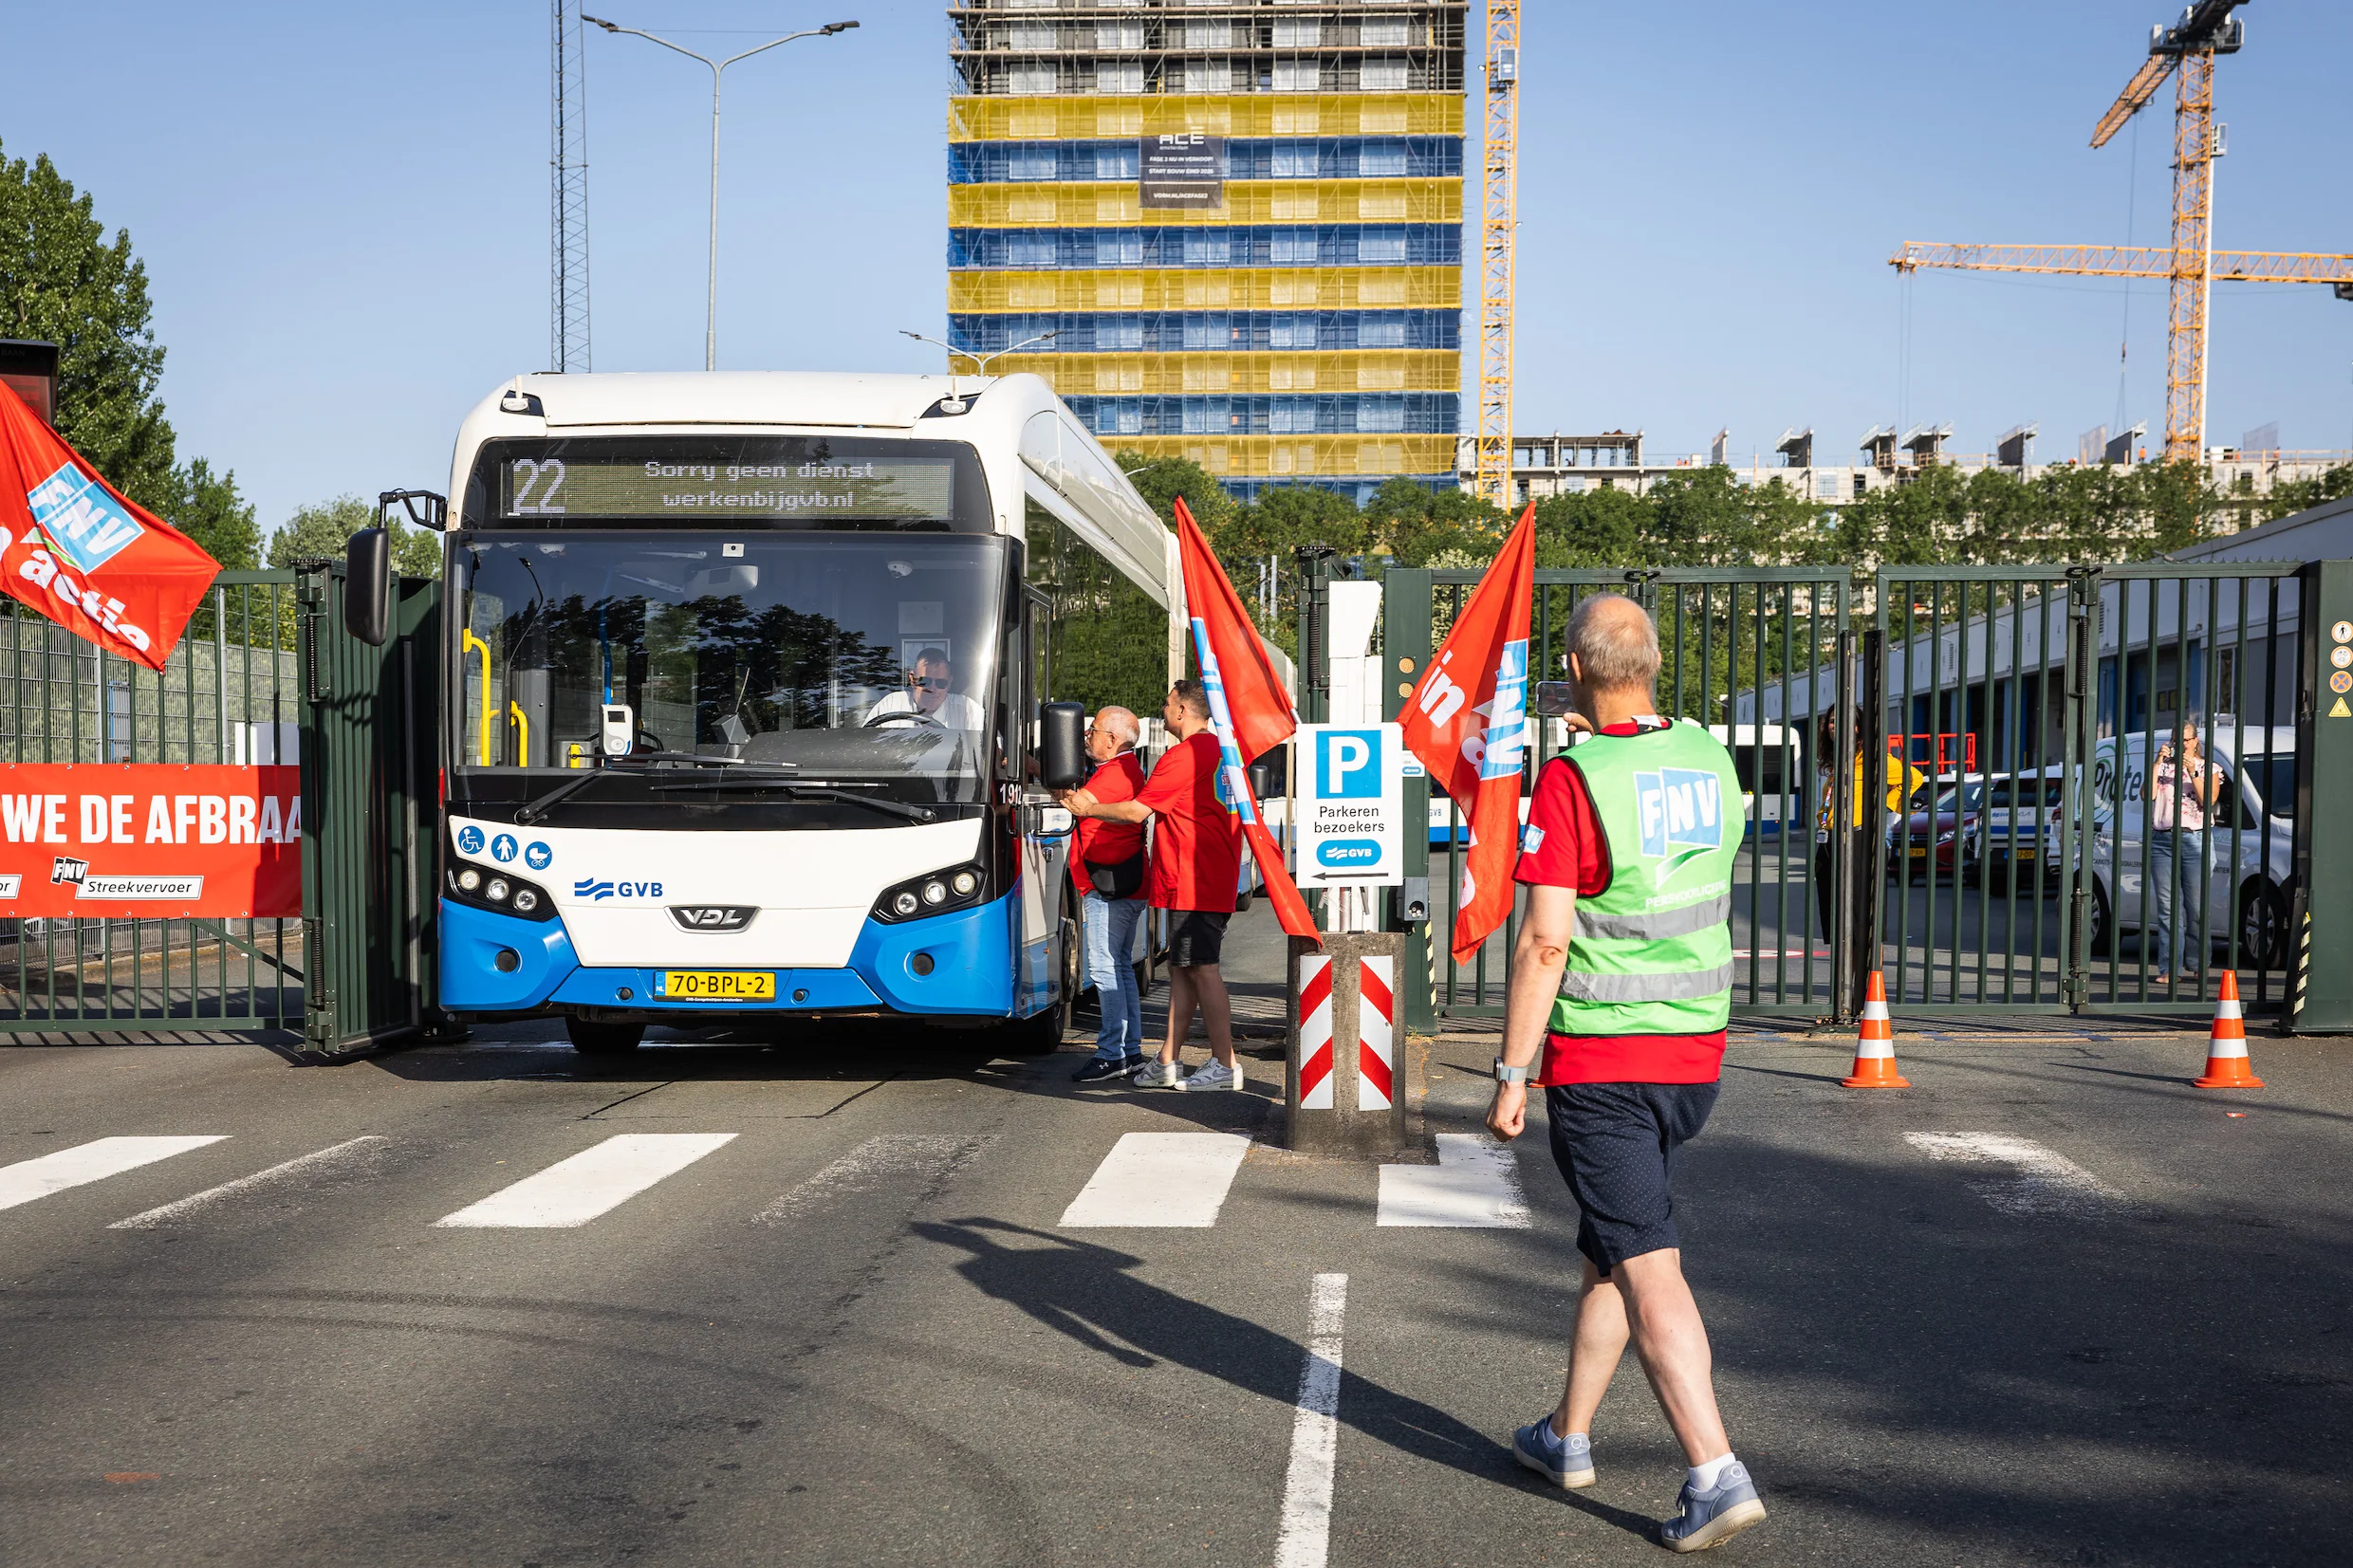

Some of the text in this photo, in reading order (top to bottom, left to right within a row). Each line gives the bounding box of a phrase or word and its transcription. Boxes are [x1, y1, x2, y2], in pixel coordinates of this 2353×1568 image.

[1159, 126, 1204, 144] ACE
[644, 461, 874, 482] Sorry geen dienst
[512, 458, 565, 514] 22
[663, 490, 853, 510] werkenbijgvb.nl
[29, 479, 137, 555] FNV
[18, 549, 150, 653] actie
[1328, 736, 1370, 794] P
[999, 784, 1022, 805] 1912
[1319, 806, 1380, 818] Parkeren
[1641, 778, 1717, 839] FNV
[1, 794, 68, 843] WE
[80, 795, 135, 844] DE
[1314, 821, 1385, 833] bezoekers
[1348, 848, 1373, 858] GVB
[54, 862, 87, 879] FNV
[87, 880, 193, 894] Streekvervoer
[618, 882, 663, 896] GVB
[680, 909, 743, 925] VDL
[673, 975, 766, 994] 70-BPL-2
